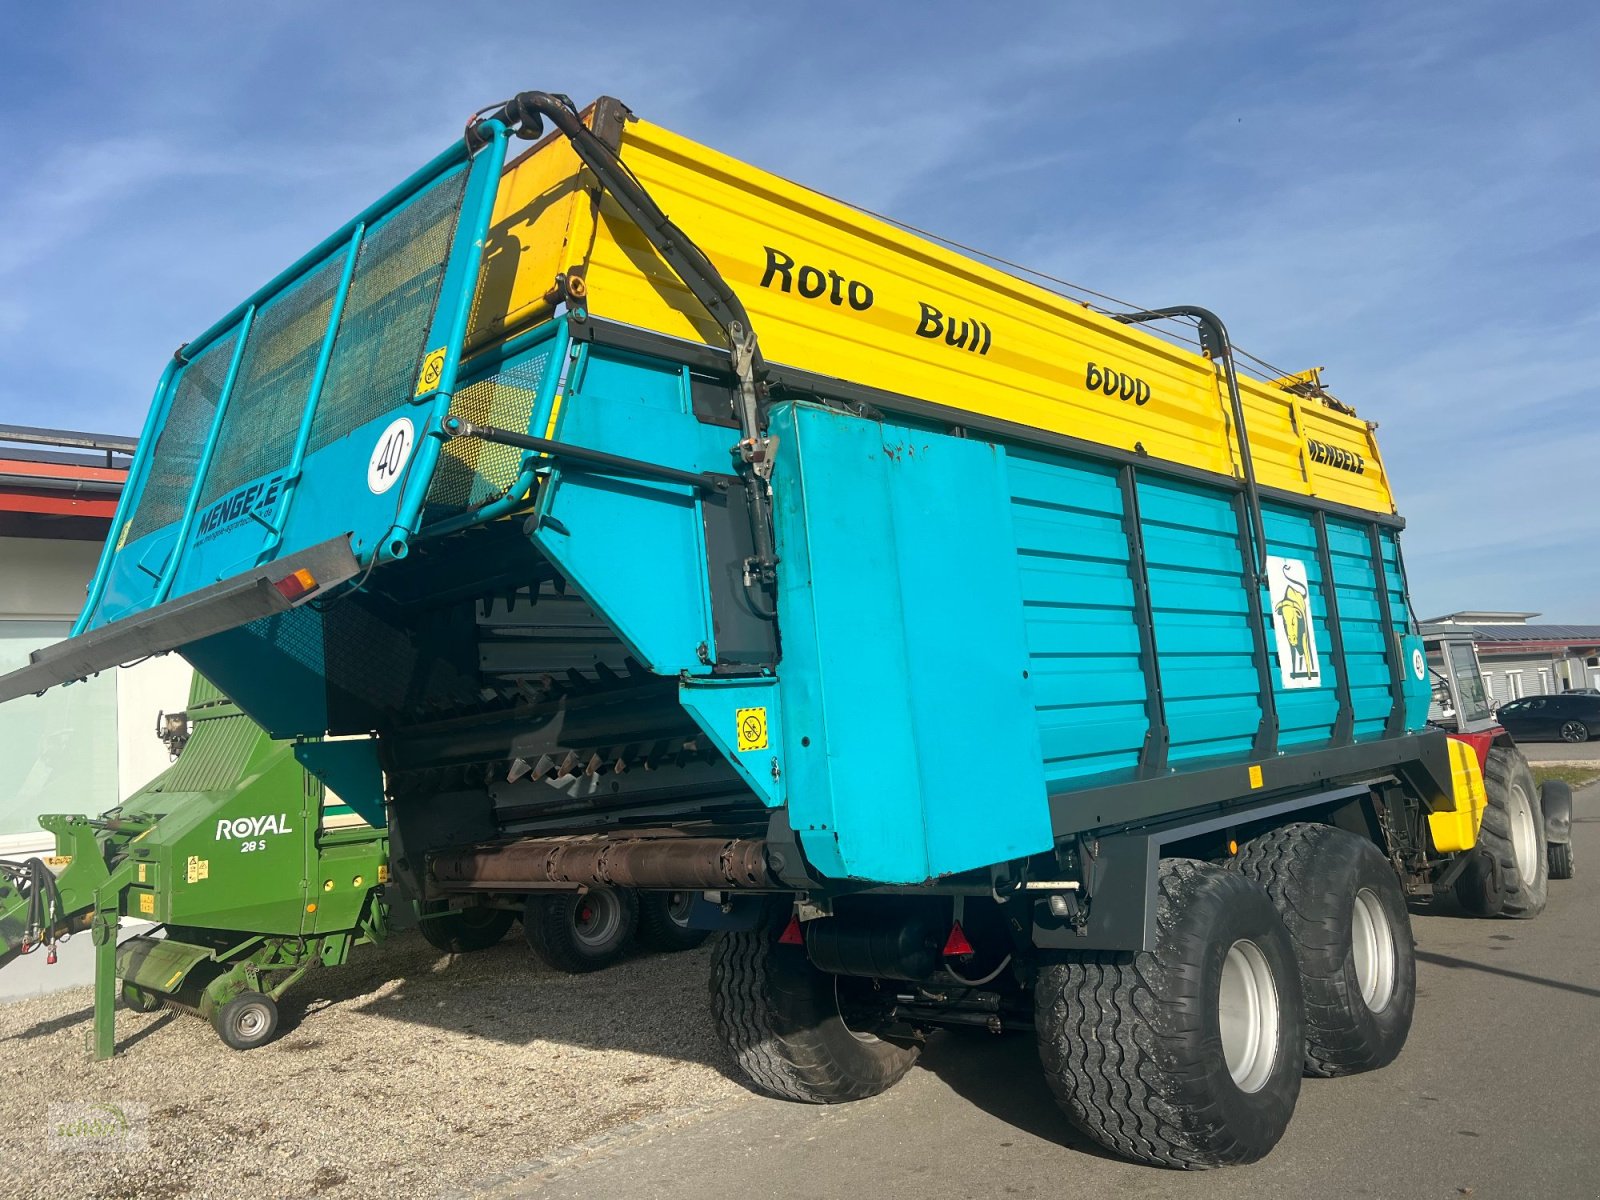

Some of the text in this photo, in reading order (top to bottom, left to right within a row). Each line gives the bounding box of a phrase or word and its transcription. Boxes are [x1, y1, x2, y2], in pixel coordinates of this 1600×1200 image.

[760, 245, 1151, 406] Roto Bull 6000
[376, 429, 405, 479] 40
[1307, 438, 1365, 475] MENGELE
[196, 475, 283, 539] MENGELE
[215, 813, 293, 841] ROYAL
[240, 839, 267, 853] 28 S
